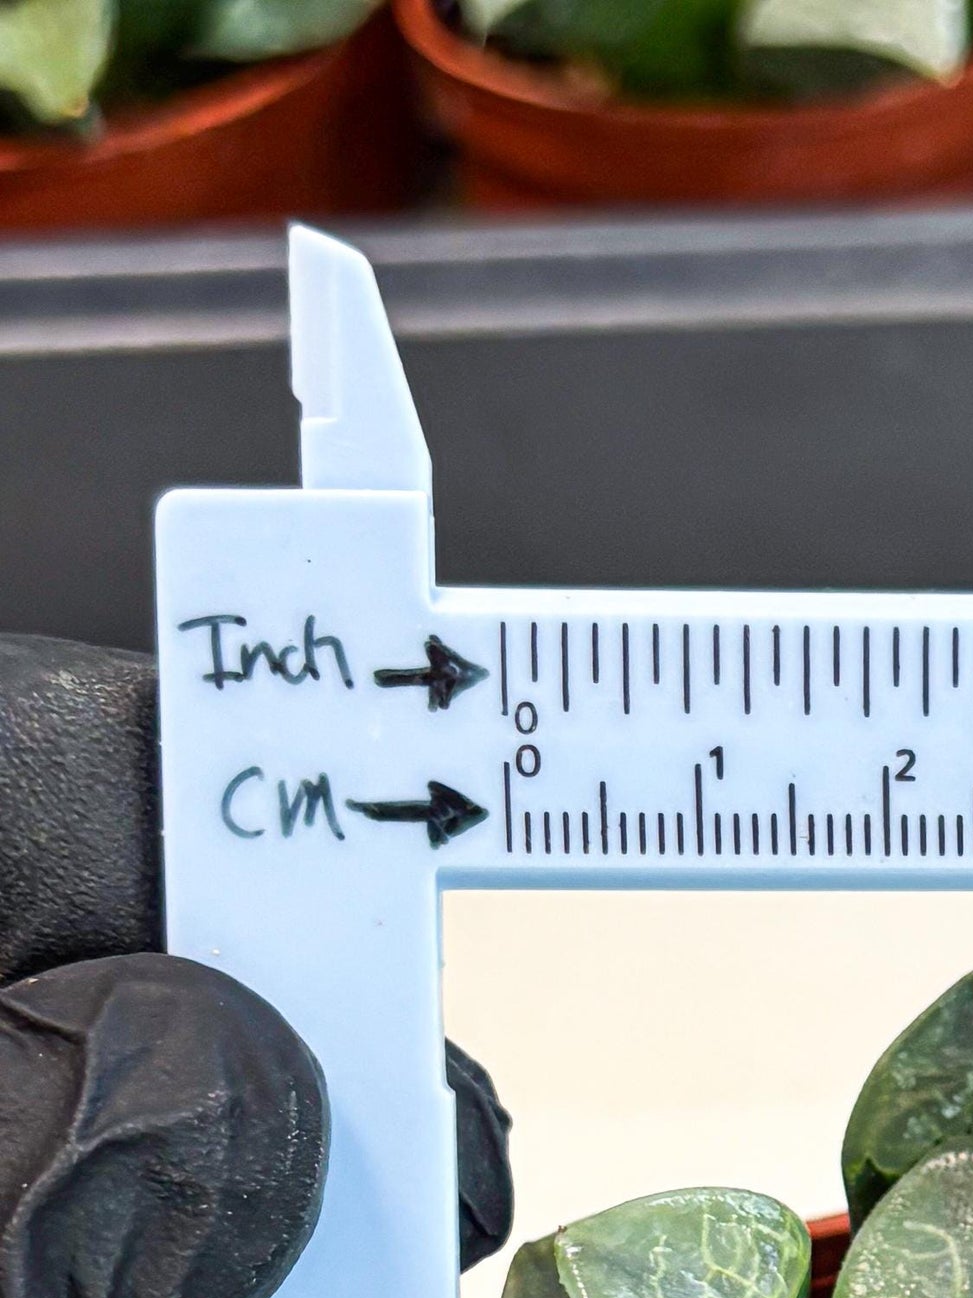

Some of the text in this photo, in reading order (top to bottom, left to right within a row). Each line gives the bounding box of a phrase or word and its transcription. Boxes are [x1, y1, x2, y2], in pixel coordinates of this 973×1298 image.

[177, 614, 355, 691] Inch
[514, 700, 539, 735] 0
[515, 743, 542, 778] 0
[708, 745, 725, 781] 1
[894, 748, 917, 783] 2
